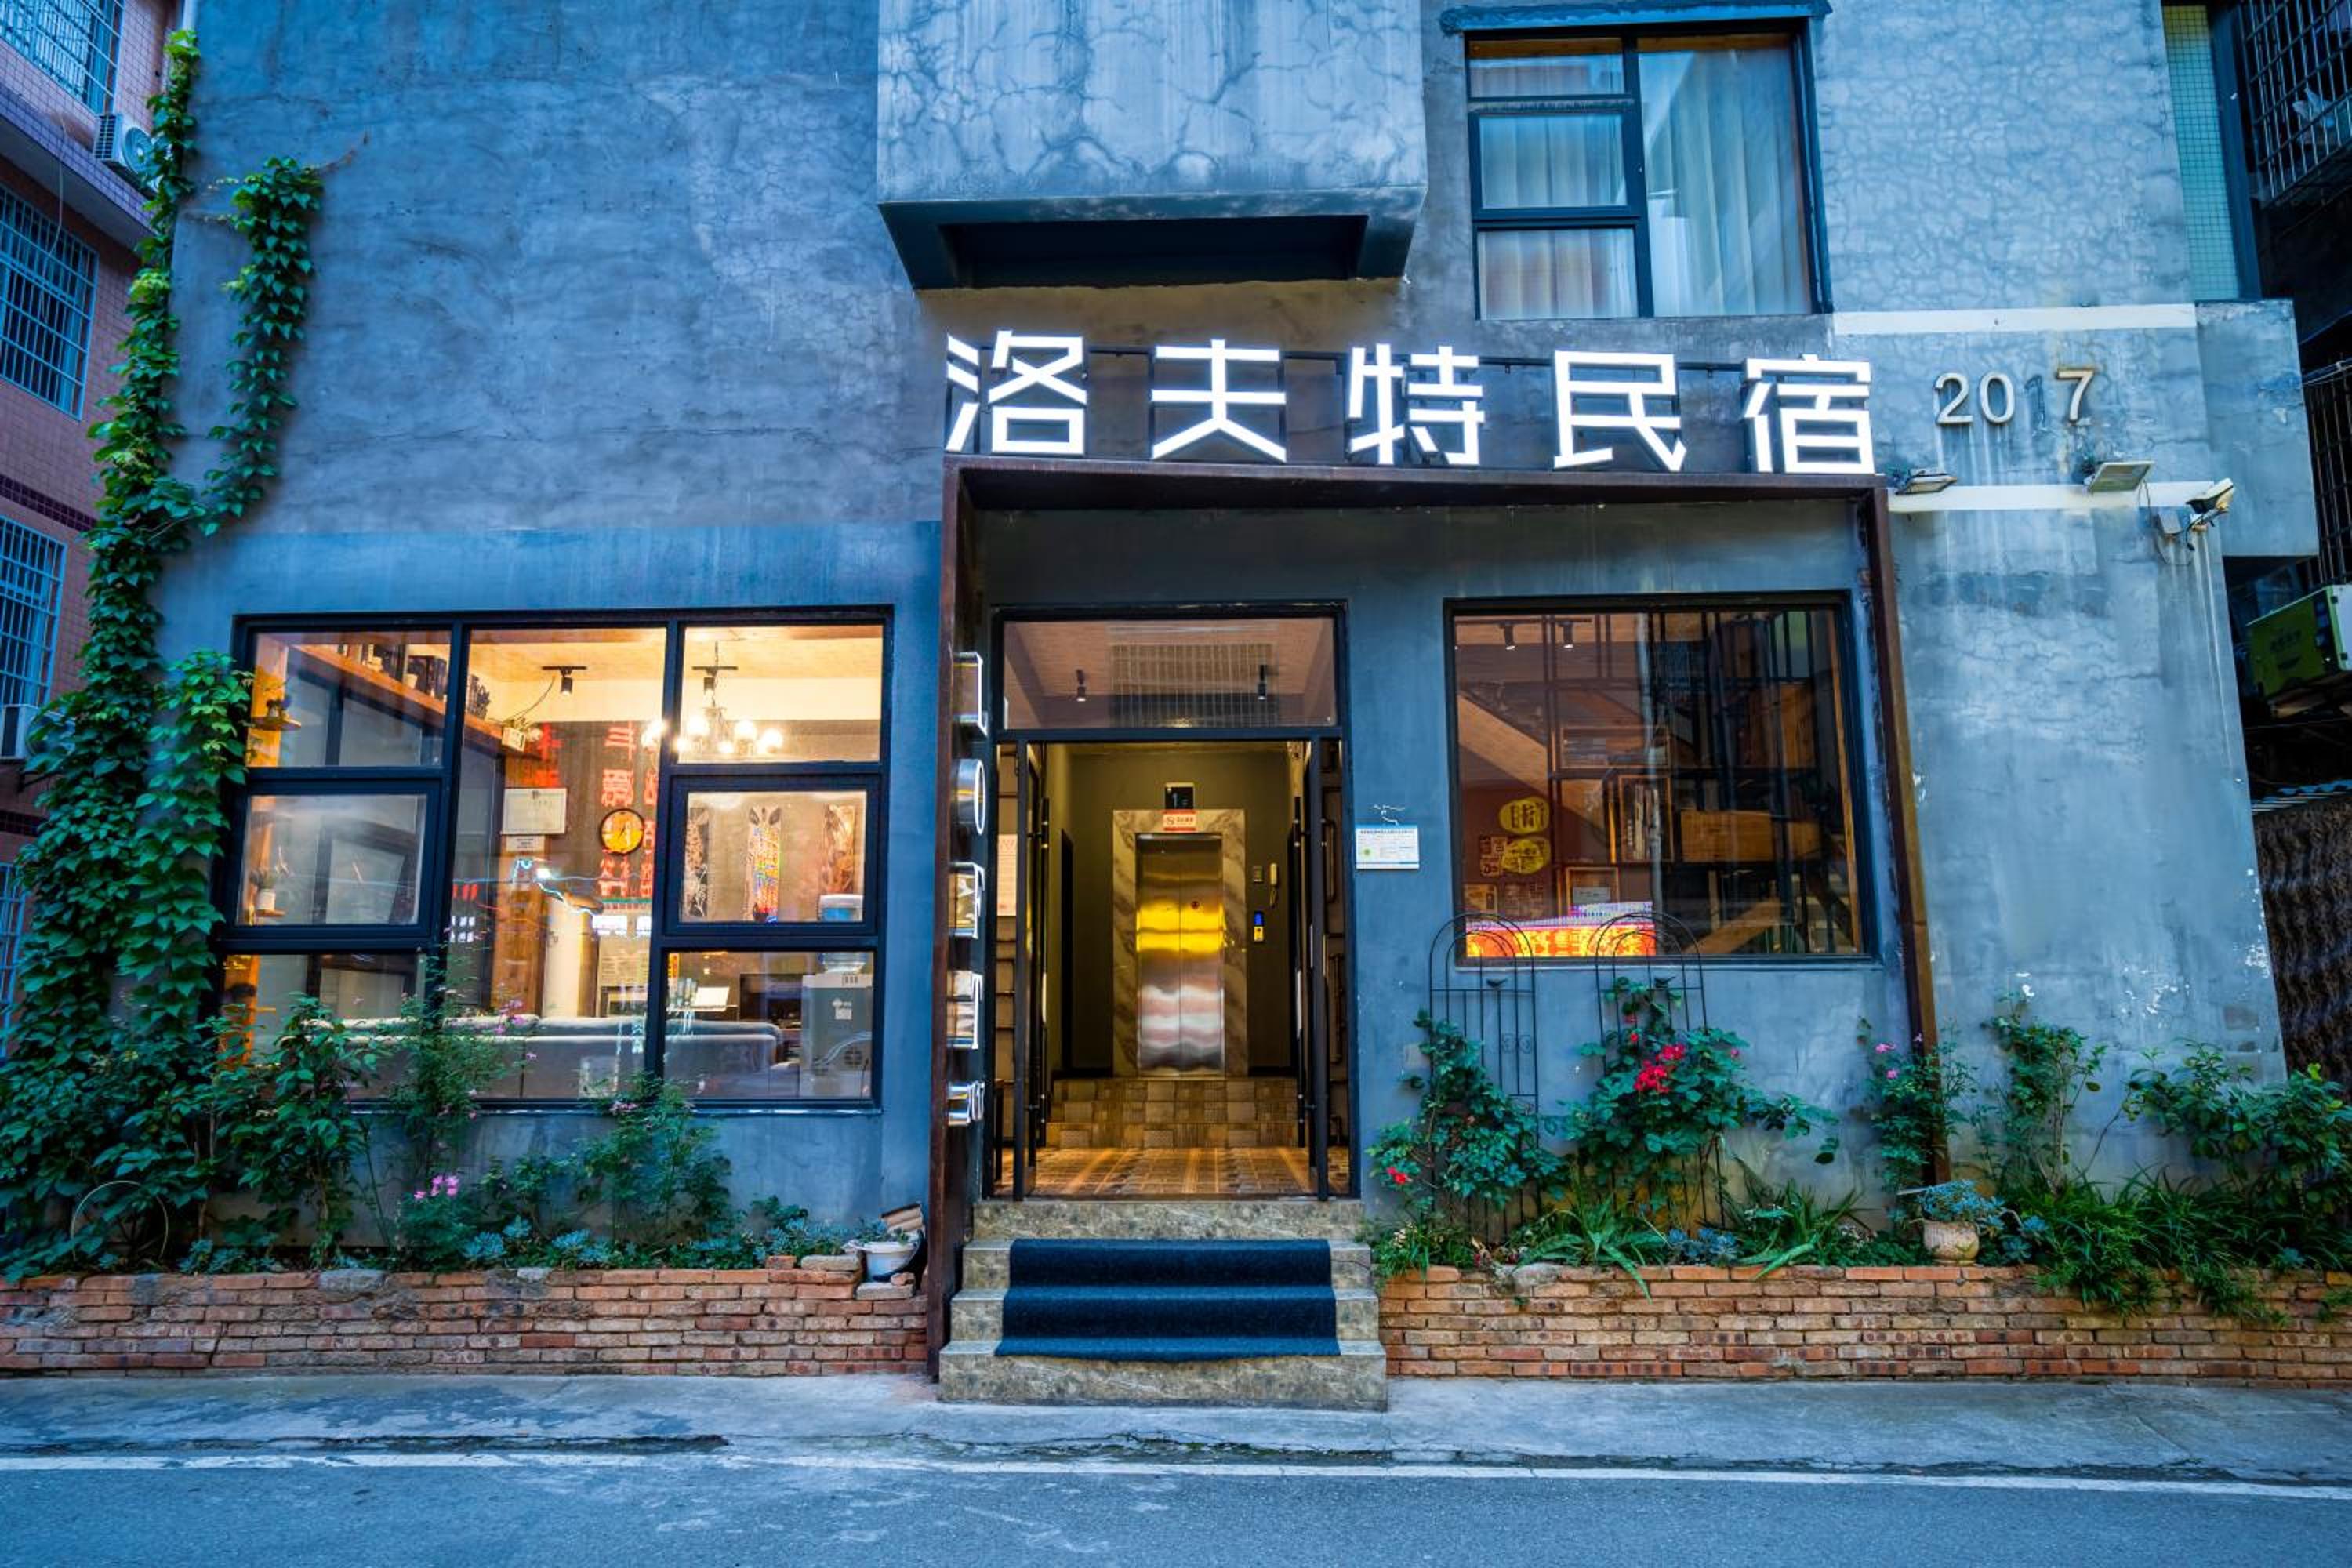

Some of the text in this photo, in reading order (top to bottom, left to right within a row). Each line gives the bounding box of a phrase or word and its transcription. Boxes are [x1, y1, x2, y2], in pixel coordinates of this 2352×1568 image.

[945, 329, 1872, 474] 洛夫特民宿
